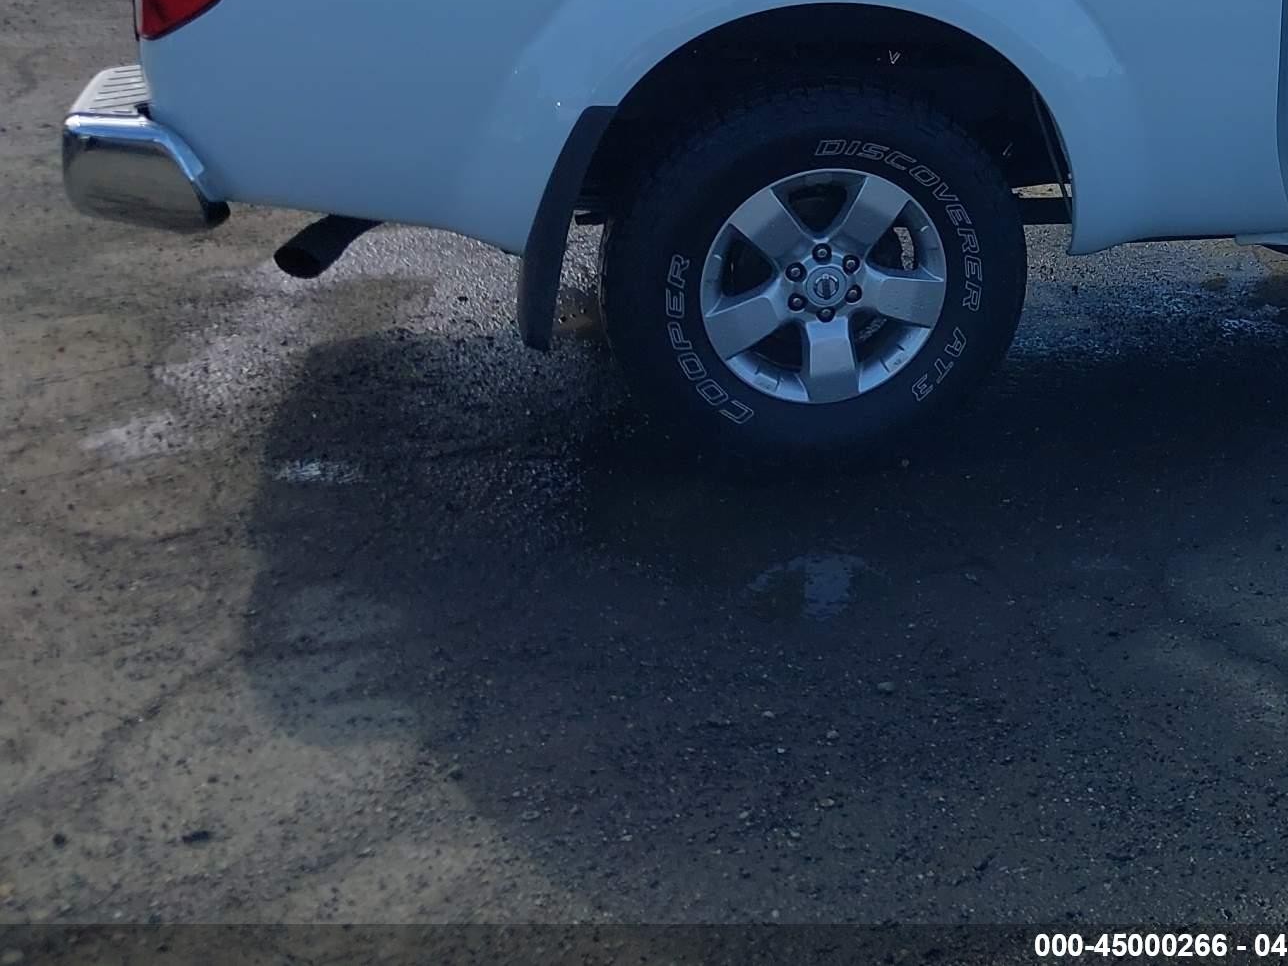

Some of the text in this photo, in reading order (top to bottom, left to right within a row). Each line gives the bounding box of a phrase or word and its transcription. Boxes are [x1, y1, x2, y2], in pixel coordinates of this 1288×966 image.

[665, 254, 754, 425] COOPER
[815, 139, 983, 402] DISCOVERER AT3
